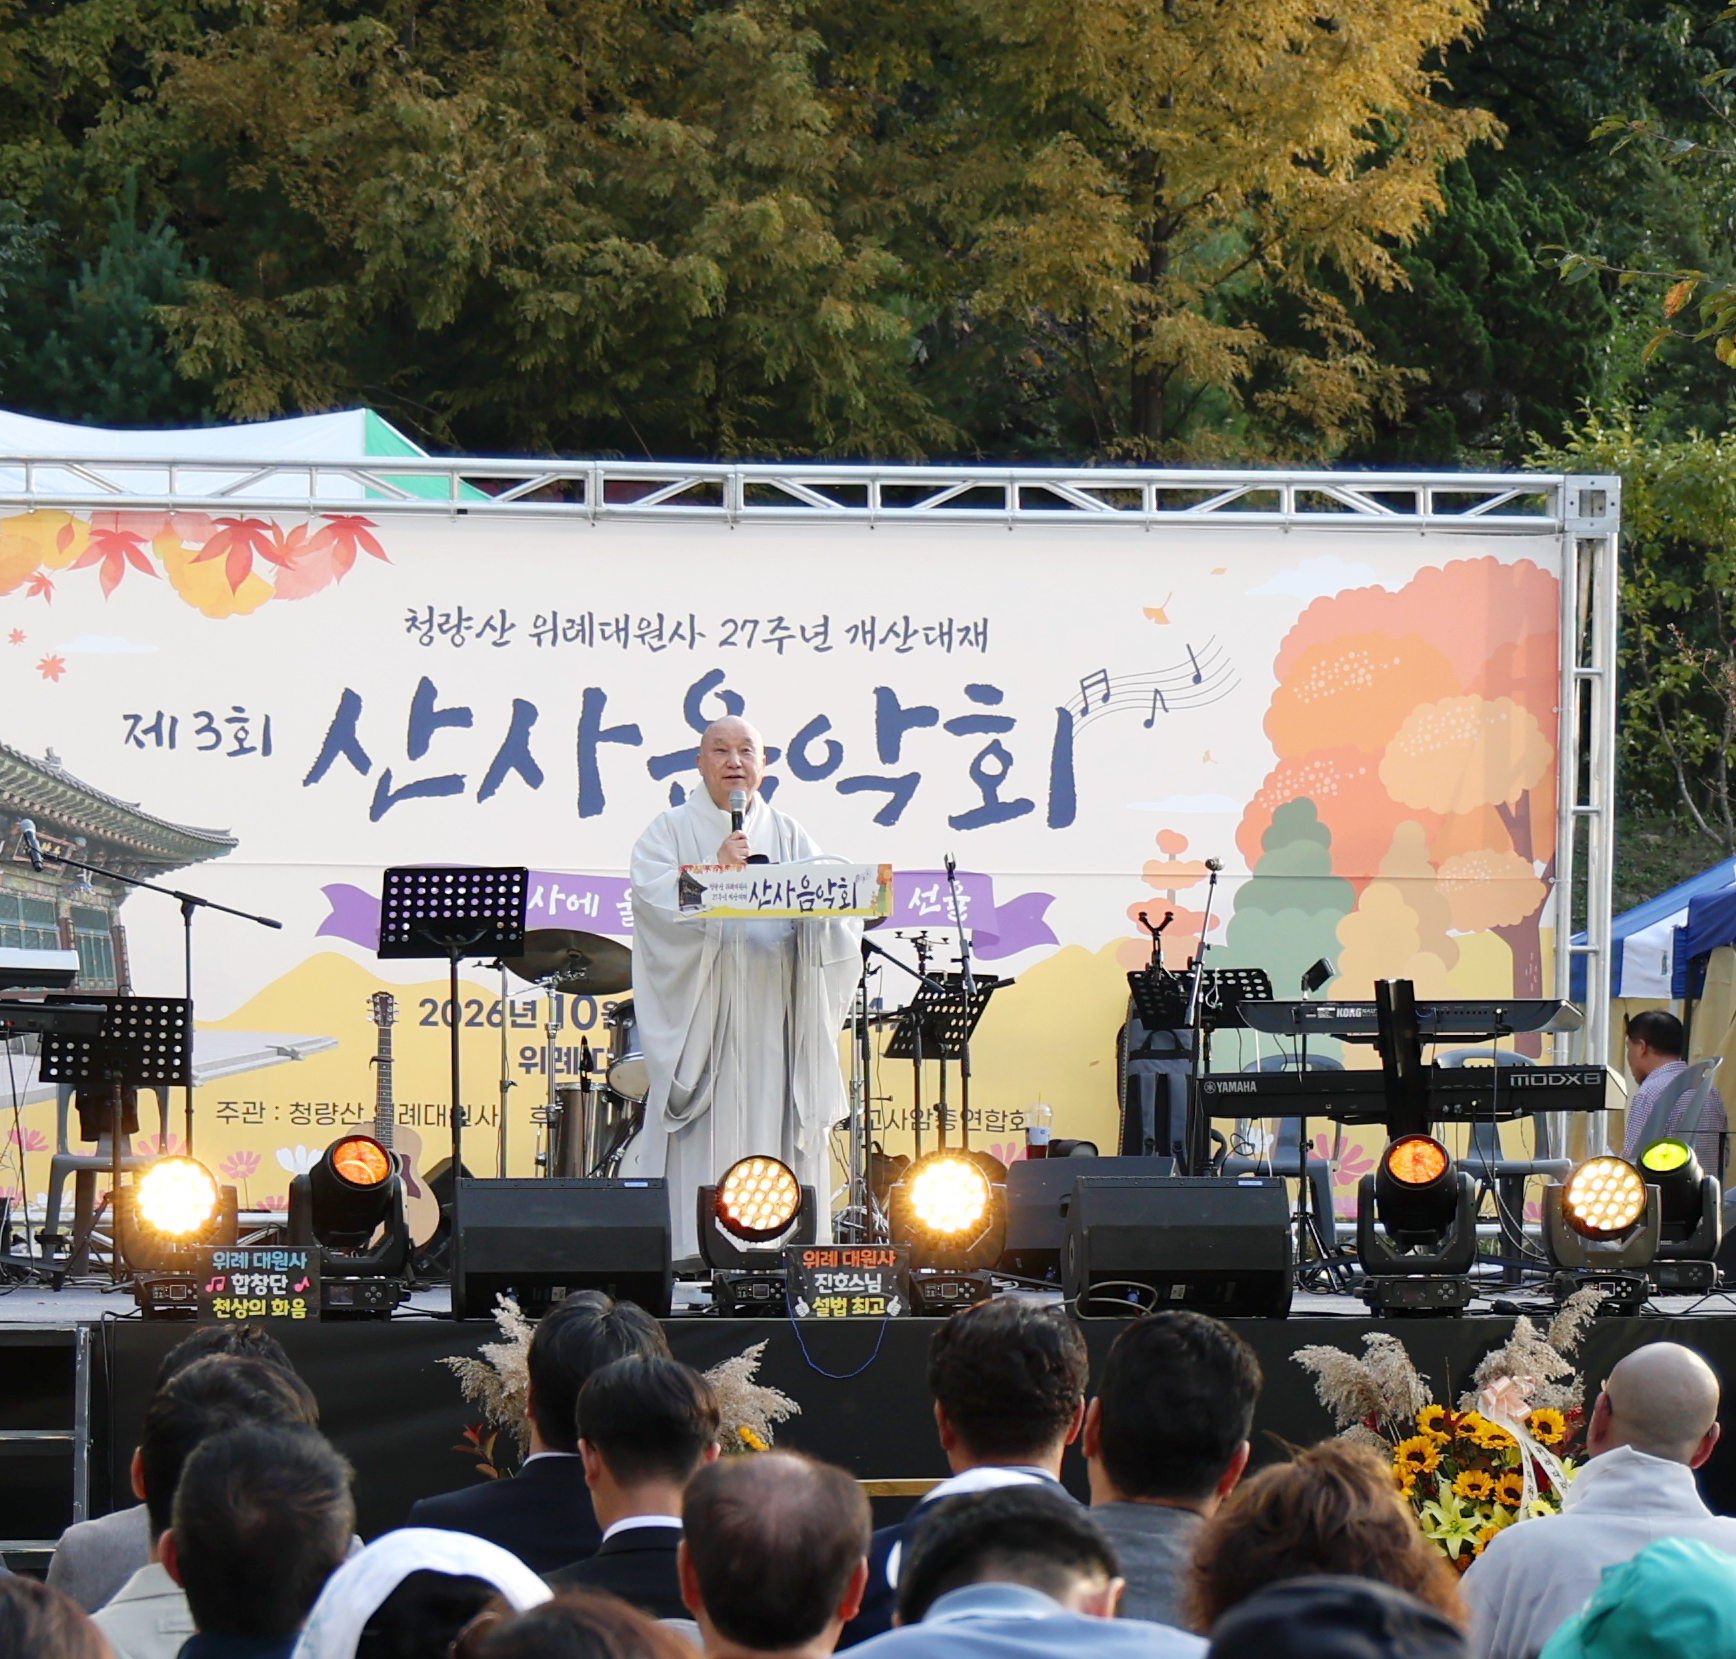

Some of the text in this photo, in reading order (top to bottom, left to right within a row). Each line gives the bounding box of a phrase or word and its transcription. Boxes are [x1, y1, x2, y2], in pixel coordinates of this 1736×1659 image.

[405, 605, 989, 655] 청량산 위례대원사 27주년 개산대재
[748, 874, 857, 913] 산사음악회
[908, 879, 971, 922] 선율
[418, 997, 538, 1030] 2026년
[1336, 1007, 1362, 1018] KORG
[1216, 1080, 1257, 1093] YAMAHA
[215, 1101, 266, 1126] 주관
[289, 1100, 365, 1126] 청량산
[212, 1250, 308, 1272] 위례 대원사
[802, 1249, 897, 1270] 위례 대원사
[230, 1272, 289, 1296] 합창단
[814, 1272, 882, 1294] 진호스님
[212, 1297, 308, 1319] 천상의 화음
[812, 1296, 886, 1318] 설법 최고
